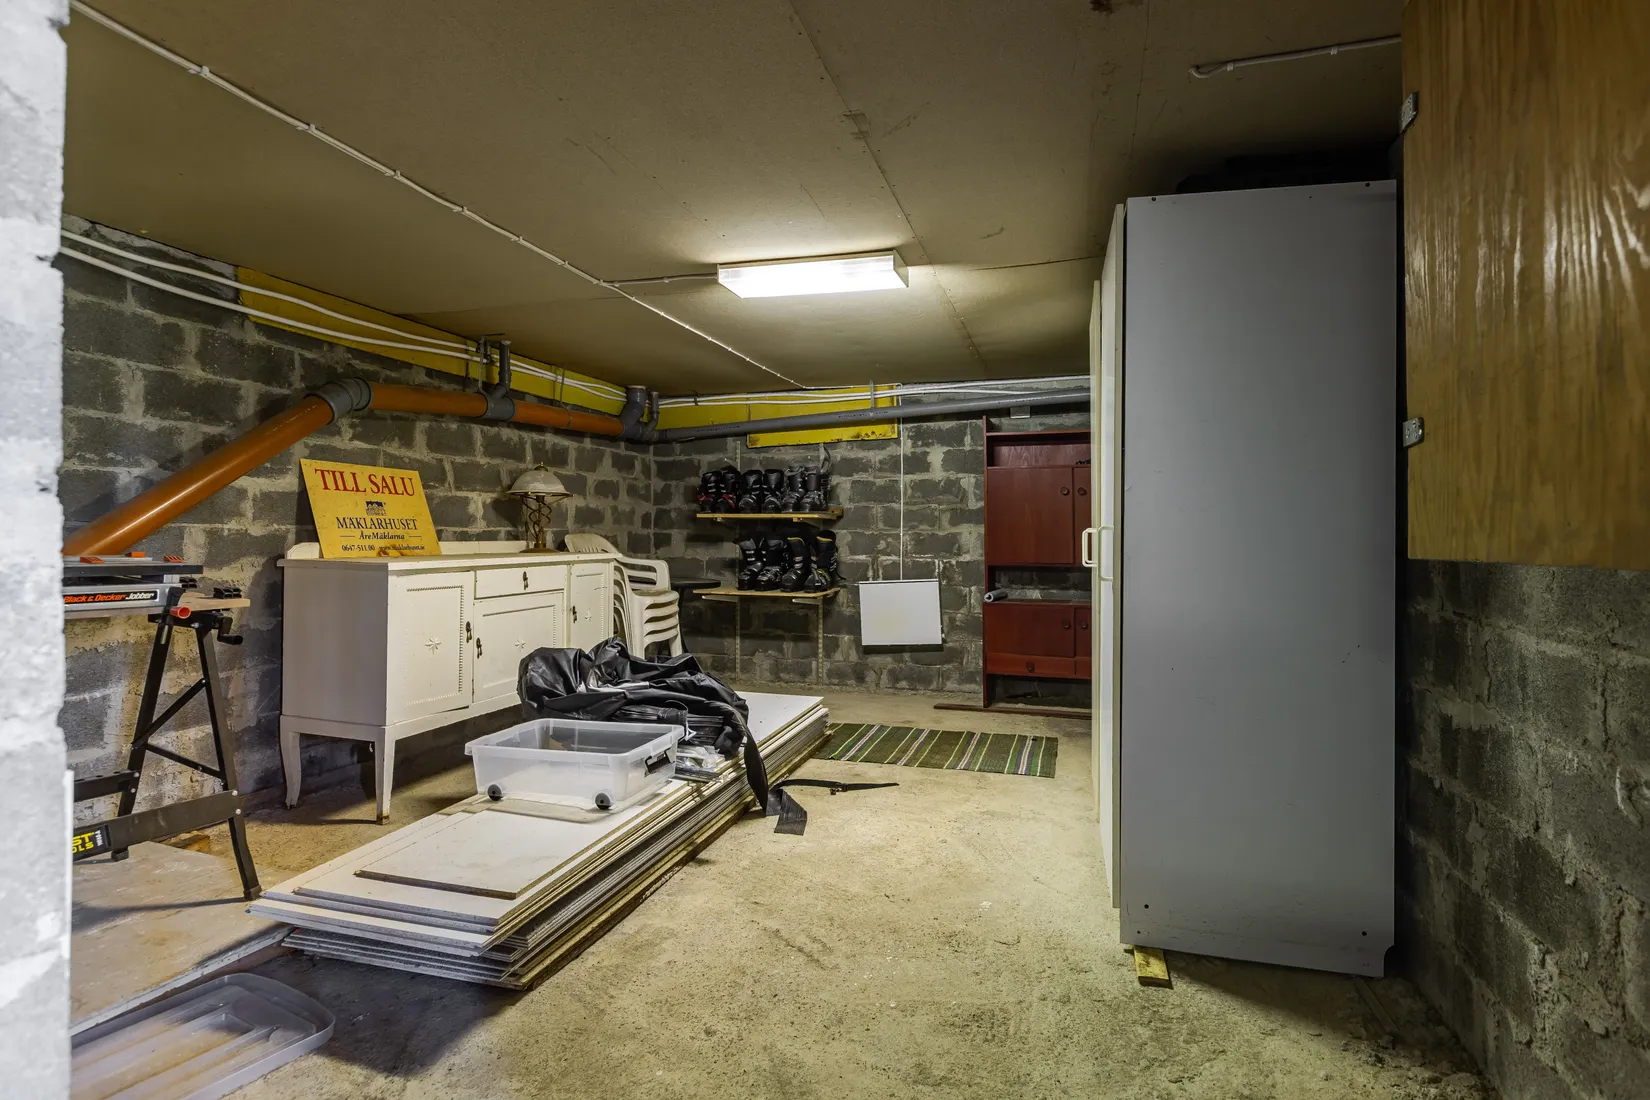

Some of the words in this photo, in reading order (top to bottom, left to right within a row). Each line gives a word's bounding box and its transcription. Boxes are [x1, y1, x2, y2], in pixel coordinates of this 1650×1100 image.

[314, 468, 367, 493] TILL
[368, 473, 415, 497] SALU
[94, 594, 126, 602] Decker
[125, 592, 155, 600] Jobber
